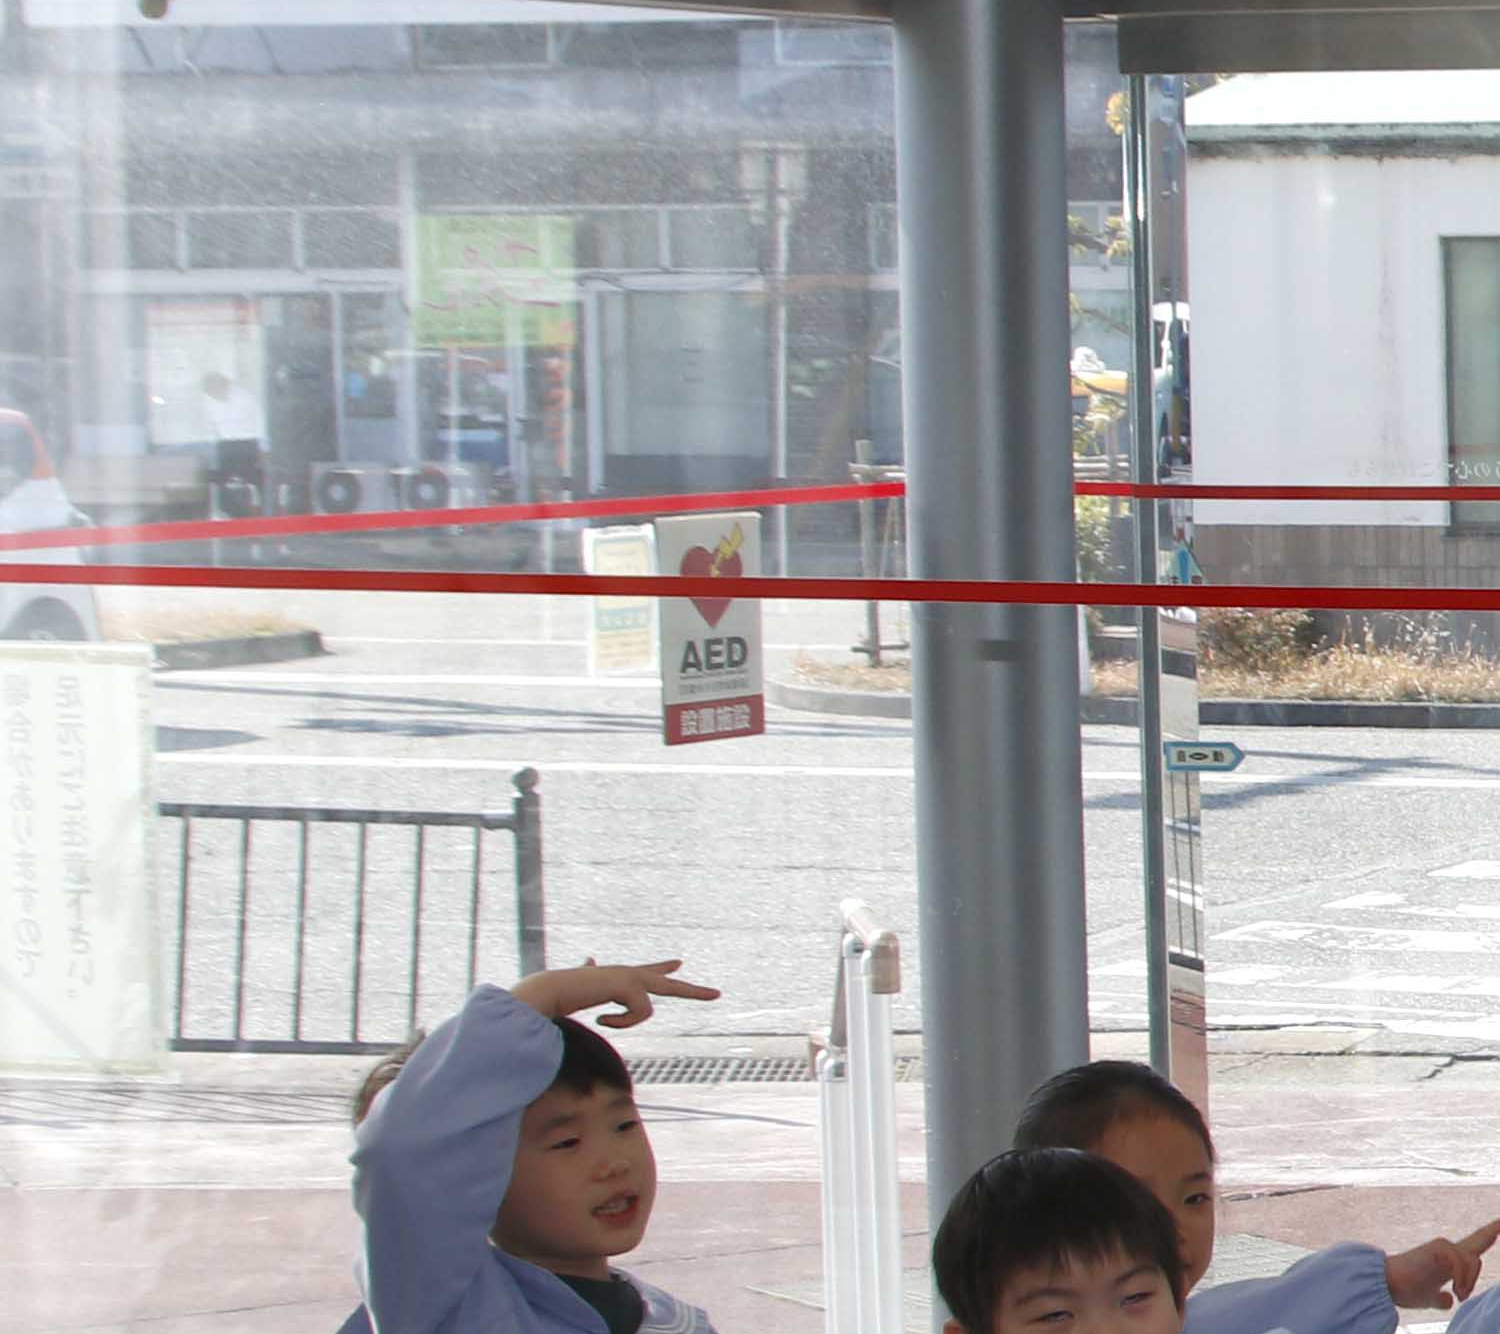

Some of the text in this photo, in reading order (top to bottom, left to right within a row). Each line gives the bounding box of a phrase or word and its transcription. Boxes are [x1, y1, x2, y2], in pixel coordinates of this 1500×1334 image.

[680, 636, 748, 674] AED
[679, 703, 751, 737] 設置施設
